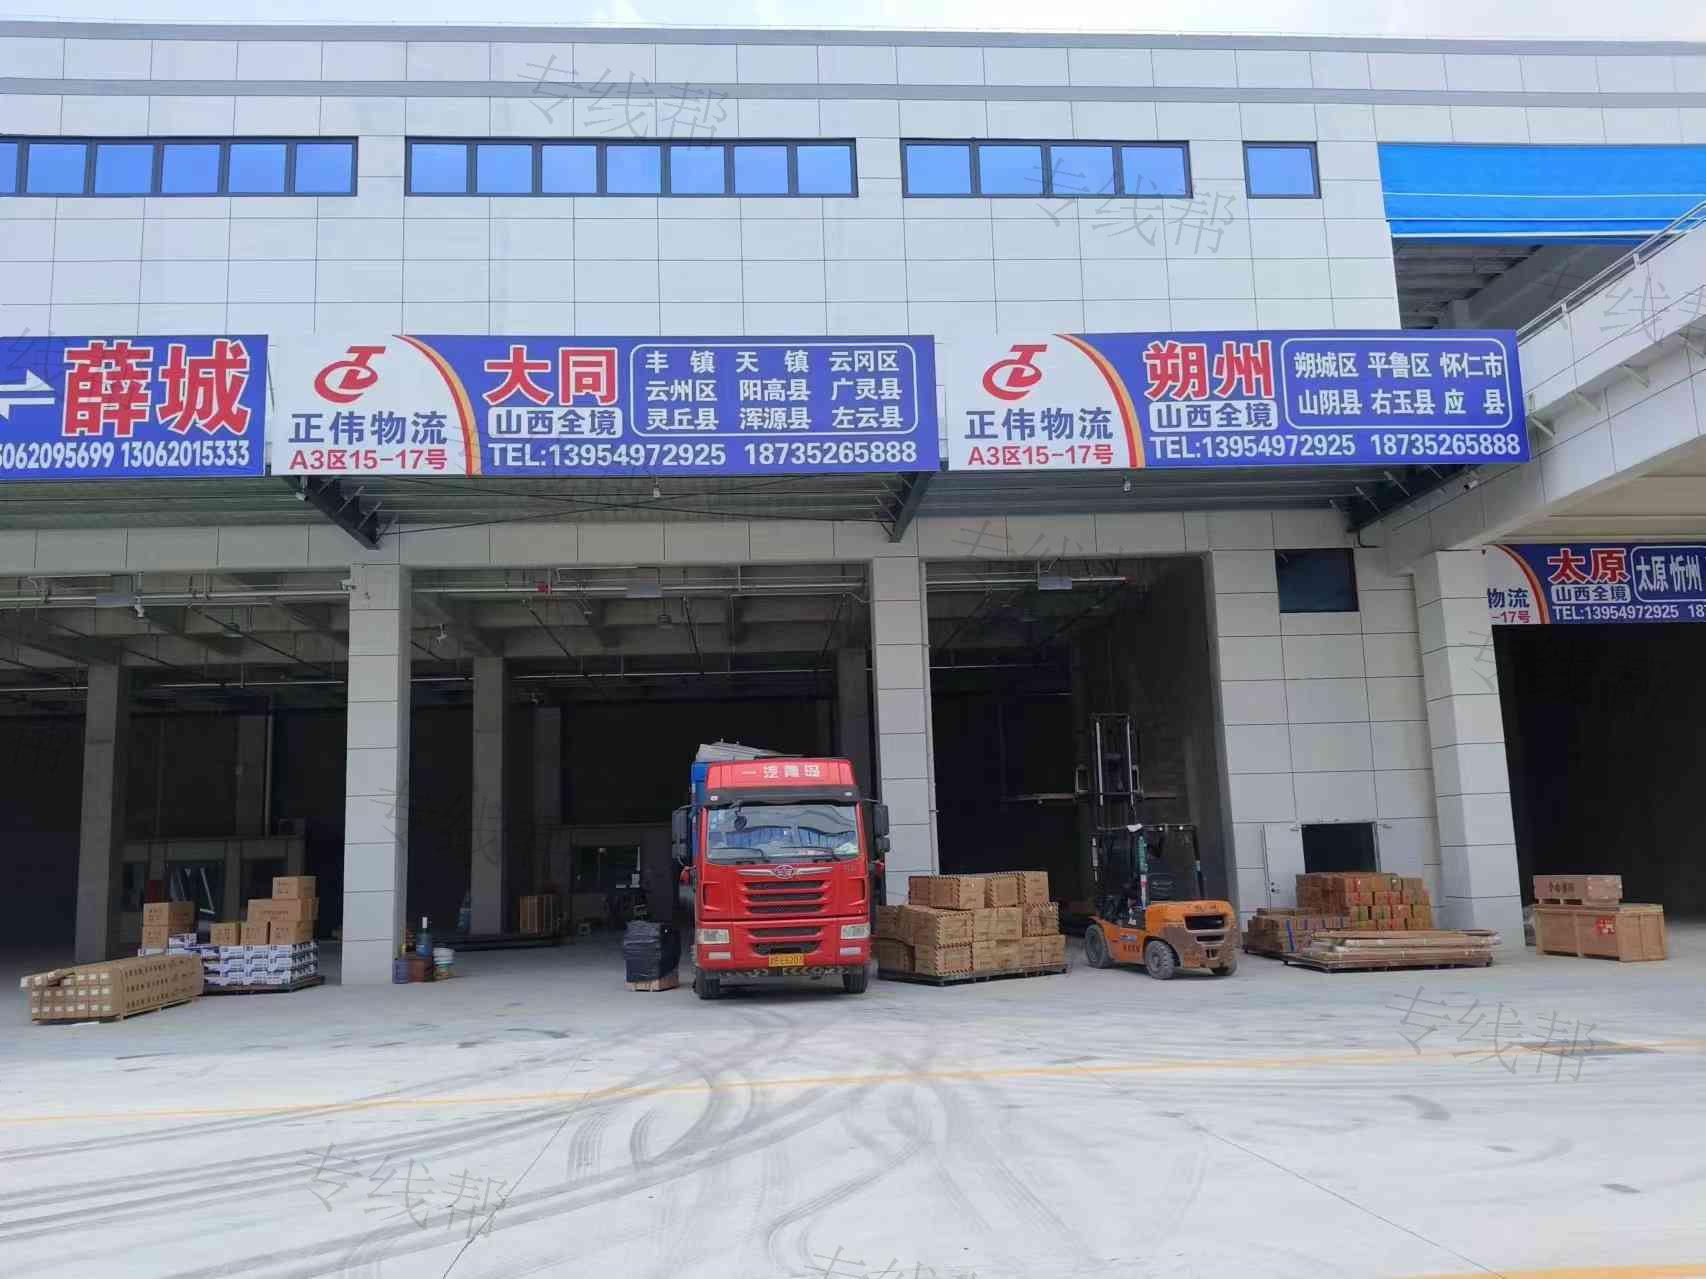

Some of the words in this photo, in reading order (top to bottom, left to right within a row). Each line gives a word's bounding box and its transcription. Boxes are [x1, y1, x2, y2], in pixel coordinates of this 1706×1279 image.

[829, 350, 900, 373] 云冈区
[1143, 340, 1275, 401] 朔州
[1294, 352, 1359, 379] 朔城区
[1367, 352, 1432, 379] 平鲁区
[1439, 352, 1504, 379] 怀仁市
[62, 339, 251, 438] 薛城
[483, 345, 618, 406] 大同
[645, 379, 718, 402] 云州区
[739, 378, 812, 402] 阳高县
[831, 377, 903, 401] 广灵县
[1298, 389, 1363, 415] 山阴县
[1370, 388, 1436, 415] 右玉县
[495, 410, 617, 436] 山西全境
[646, 407, 719, 431] 灵丘县
[739, 407, 812, 430] 浑源县
[831, 406, 903, 430] 左云县
[964, 407, 1114, 441] 正伟物流
[1156, 402, 1273, 428] 山西全境
[288, 411, 448, 446] 正伟物流
[120, 440, 250, 468] 13062015333
[488, 443, 727, 467] TEL:13954972925
[744, 441, 917, 465] 18735265888
[968, 445, 1114, 466] A3区15-17号
[1150, 435, 1356, 459] TEL:13954972925
[1370, 433, 1521, 456] 18735265888
[289, 449, 448, 471] A3区15-17号
[1547, 548, 1631, 585] 太原
[1635, 555, 1669, 592] 太原
[1555, 586, 1628, 602] 山西全境
[1552, 604, 1679, 620] TEL:13954972925
[1688, 603, 1706, 618] 18
